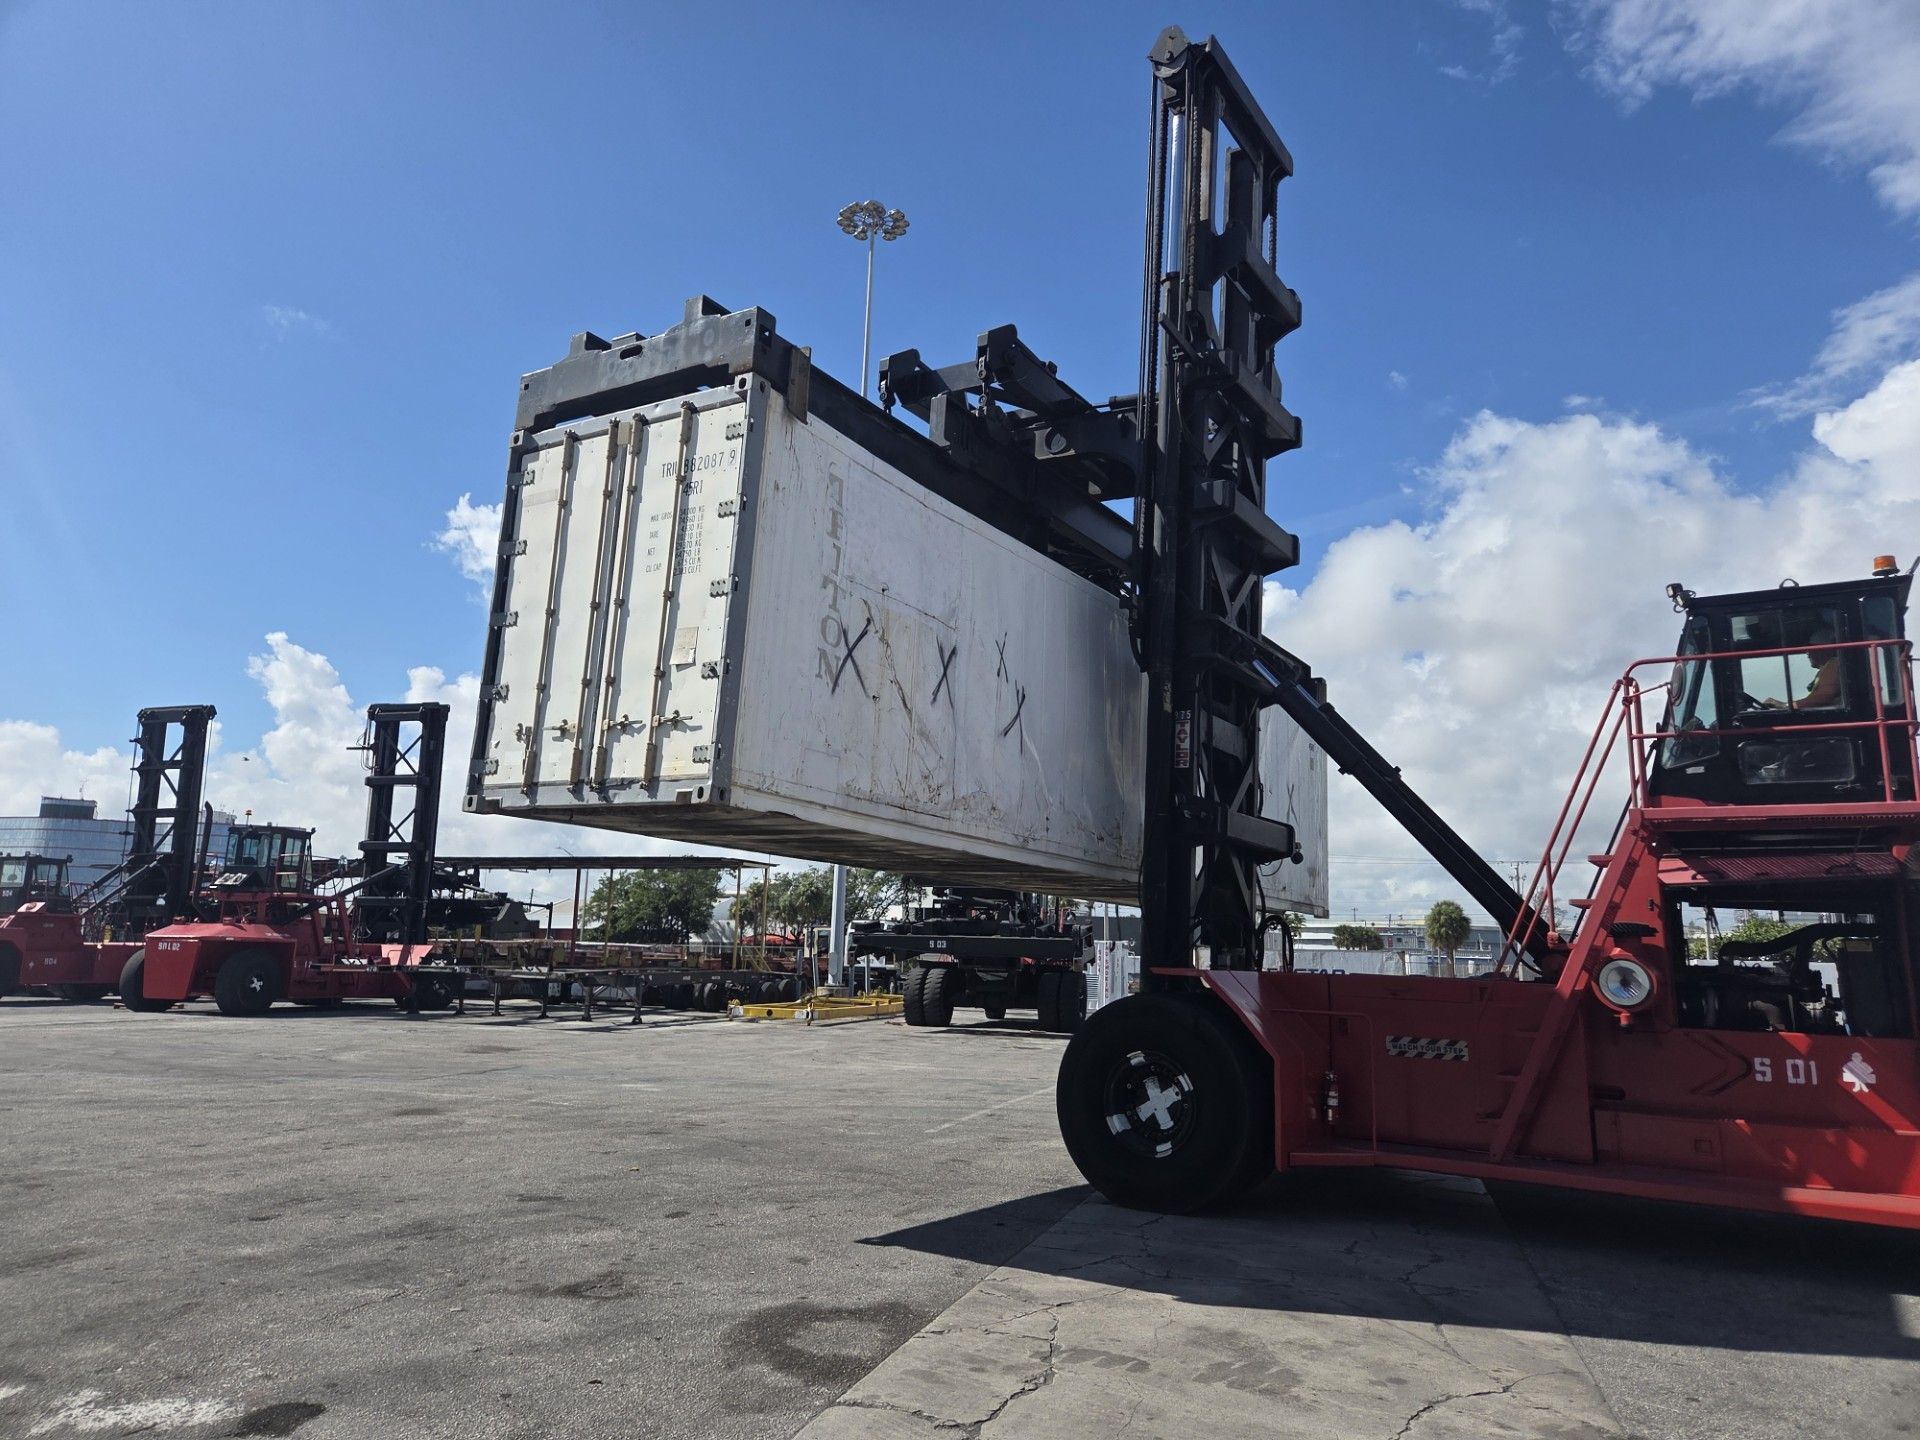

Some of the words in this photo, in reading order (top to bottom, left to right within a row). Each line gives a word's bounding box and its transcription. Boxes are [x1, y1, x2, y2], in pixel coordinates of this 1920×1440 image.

[684, 452, 724, 474] 882087
[730, 450, 736, 465] 9
[1174, 720, 1190, 768] TAYLOR
[1391, 1043, 1418, 1051] WATCH
[1420, 1045, 1442, 1053] YOUR
[1443, 1047, 1464, 1055] STEP
[1754, 1057, 1773, 1082] S
[1785, 1058, 1818, 1085] 01
